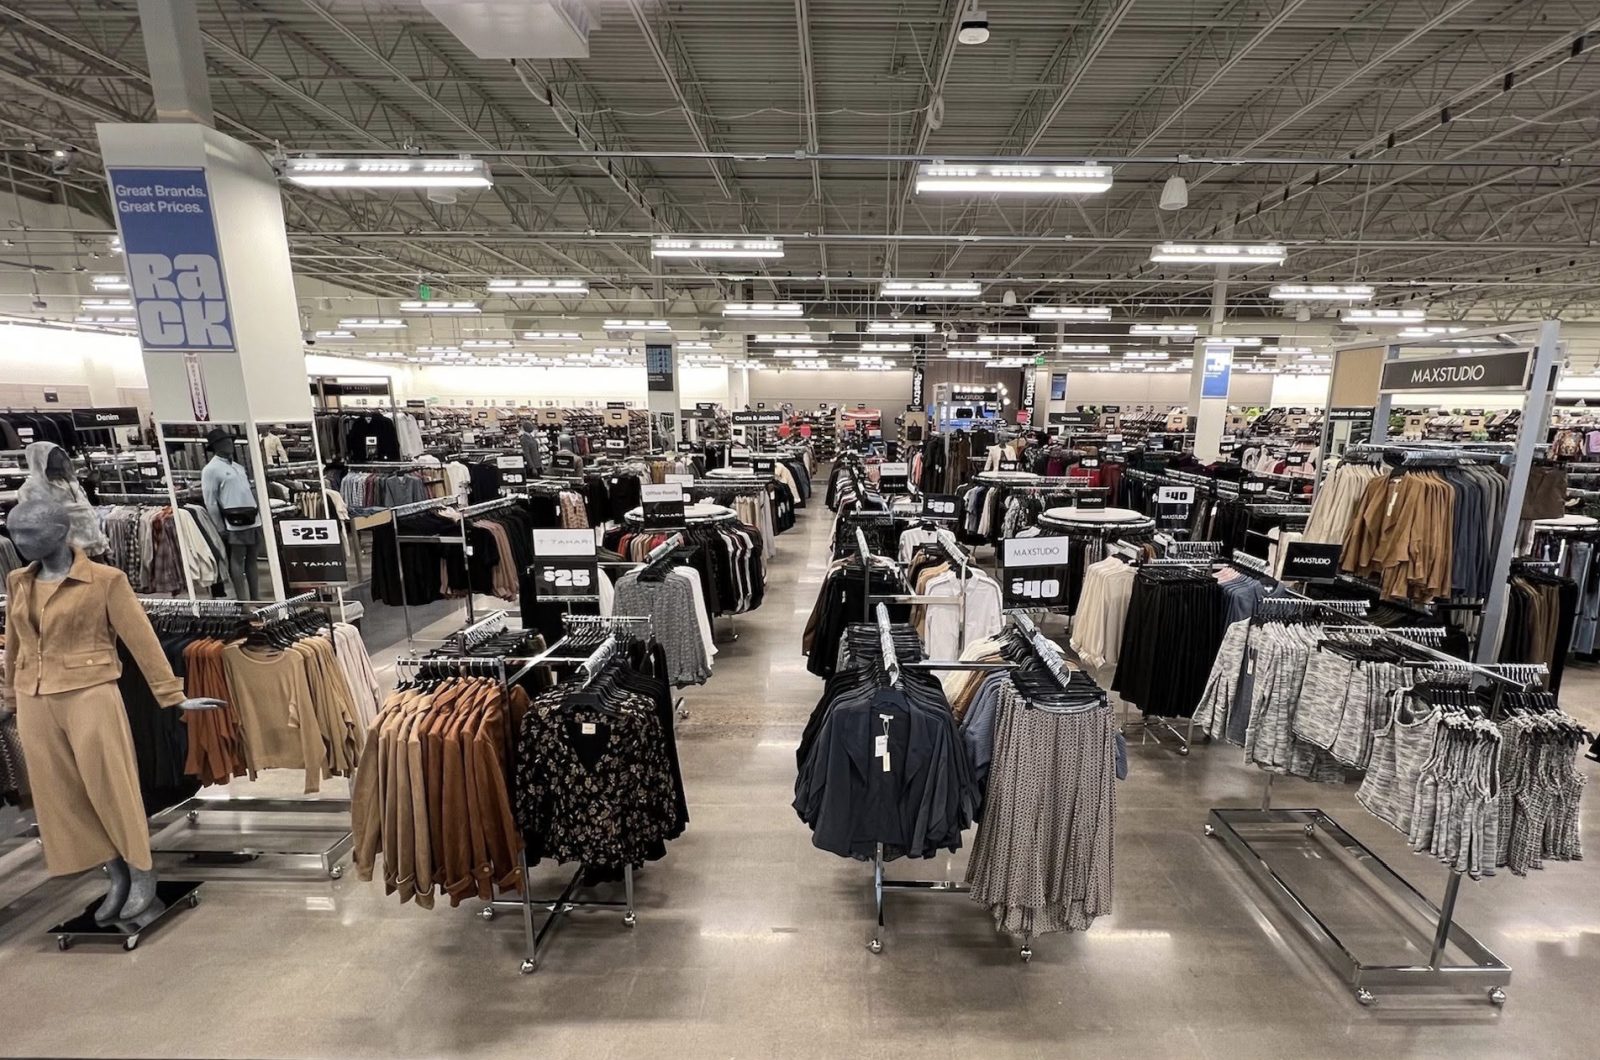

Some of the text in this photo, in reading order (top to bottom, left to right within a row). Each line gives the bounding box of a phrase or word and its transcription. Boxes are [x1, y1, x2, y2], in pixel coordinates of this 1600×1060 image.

[115, 184, 206, 198] Great Brands.
[118, 200, 204, 214] Great Prices.
[1410, 364, 1485, 383] MAXSTUDIO
[96, 413, 120, 421] Denim
[1165, 491, 1188, 500] $40
[292, 526, 329, 540] $25
[1013, 547, 1059, 557] MAXSTUDIO
[1293, 555, 1331, 566] MAXSTUDIO
[543, 568, 590, 587] $25
[1011, 579, 1060, 599] $40
